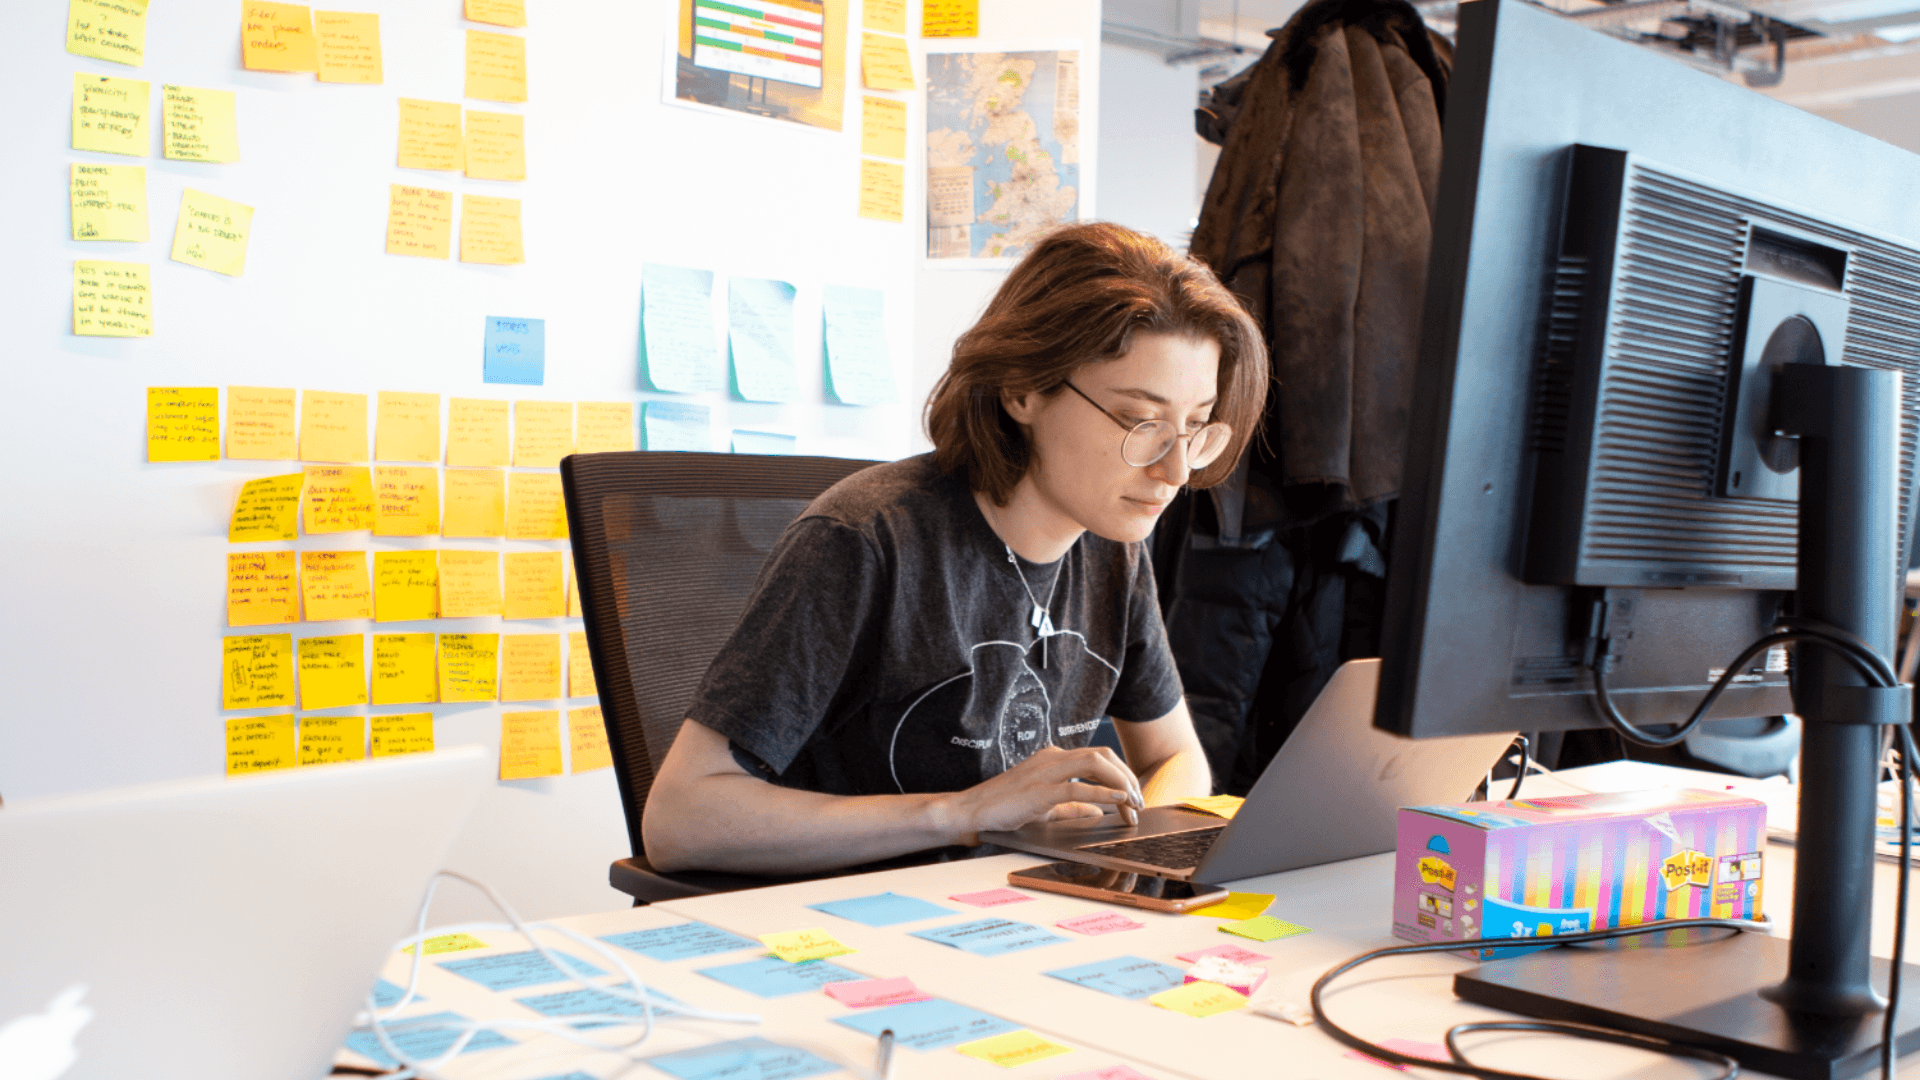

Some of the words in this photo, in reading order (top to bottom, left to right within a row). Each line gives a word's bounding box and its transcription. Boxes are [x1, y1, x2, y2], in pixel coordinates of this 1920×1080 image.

[1058, 718, 1101, 737] SURRENDE
[950, 736, 993, 749] DISCIPLI
[1017, 730, 1037, 742] FLOW
[1666, 859, 1709, 878] Post-it
